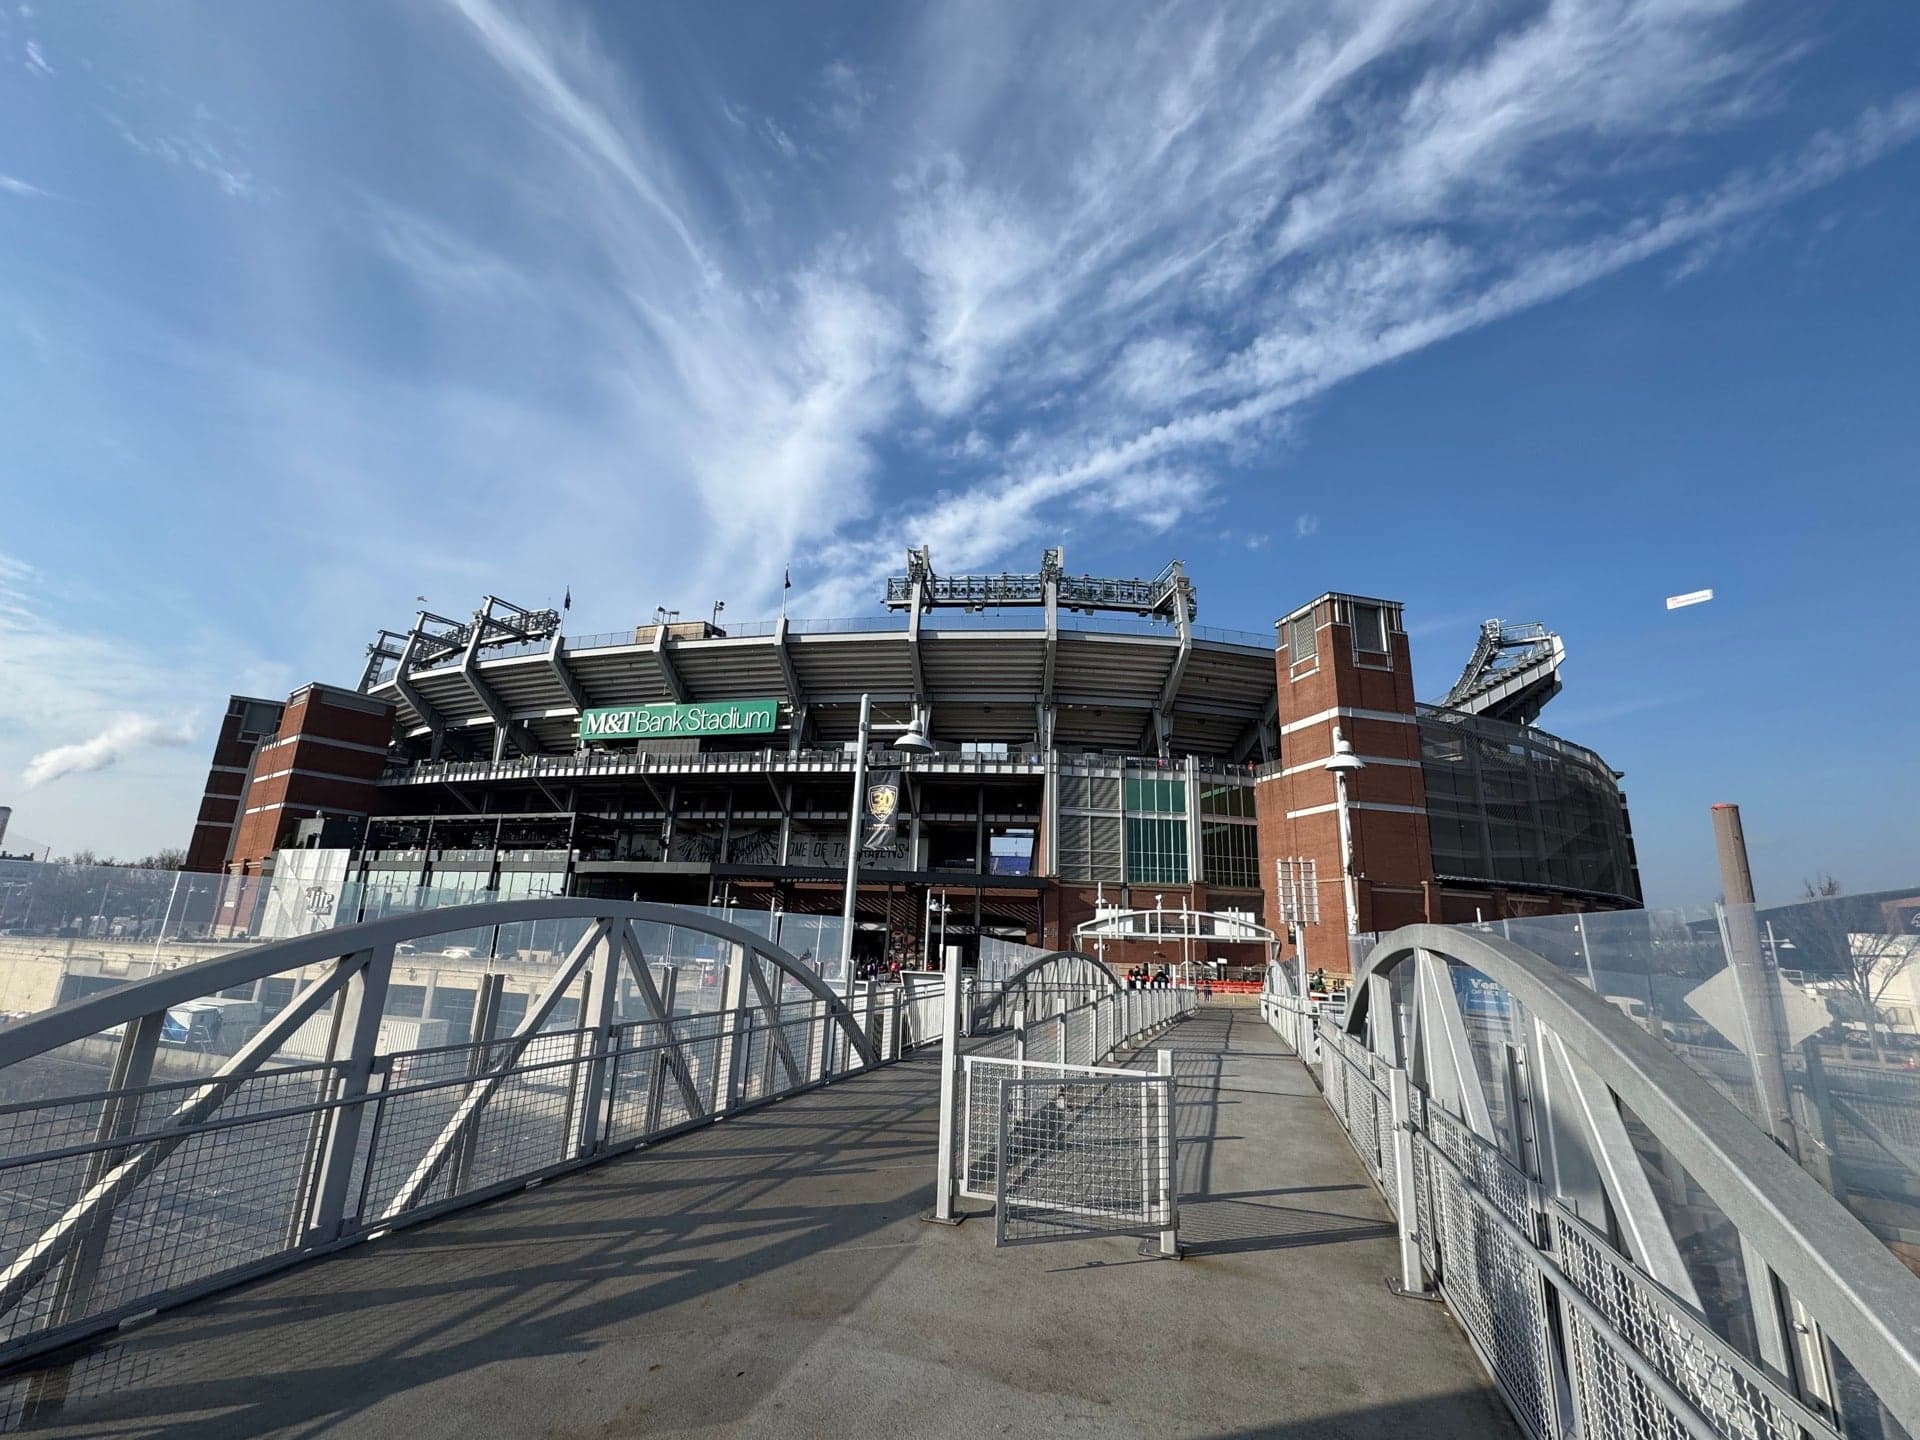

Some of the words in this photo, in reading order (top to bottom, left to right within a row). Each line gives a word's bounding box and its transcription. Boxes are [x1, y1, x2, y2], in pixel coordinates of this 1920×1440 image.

[585, 711, 636, 735] M&T
[635, 709, 684, 733] Bank
[686, 706, 770, 731] Stadium
[813, 842, 828, 858] OF
